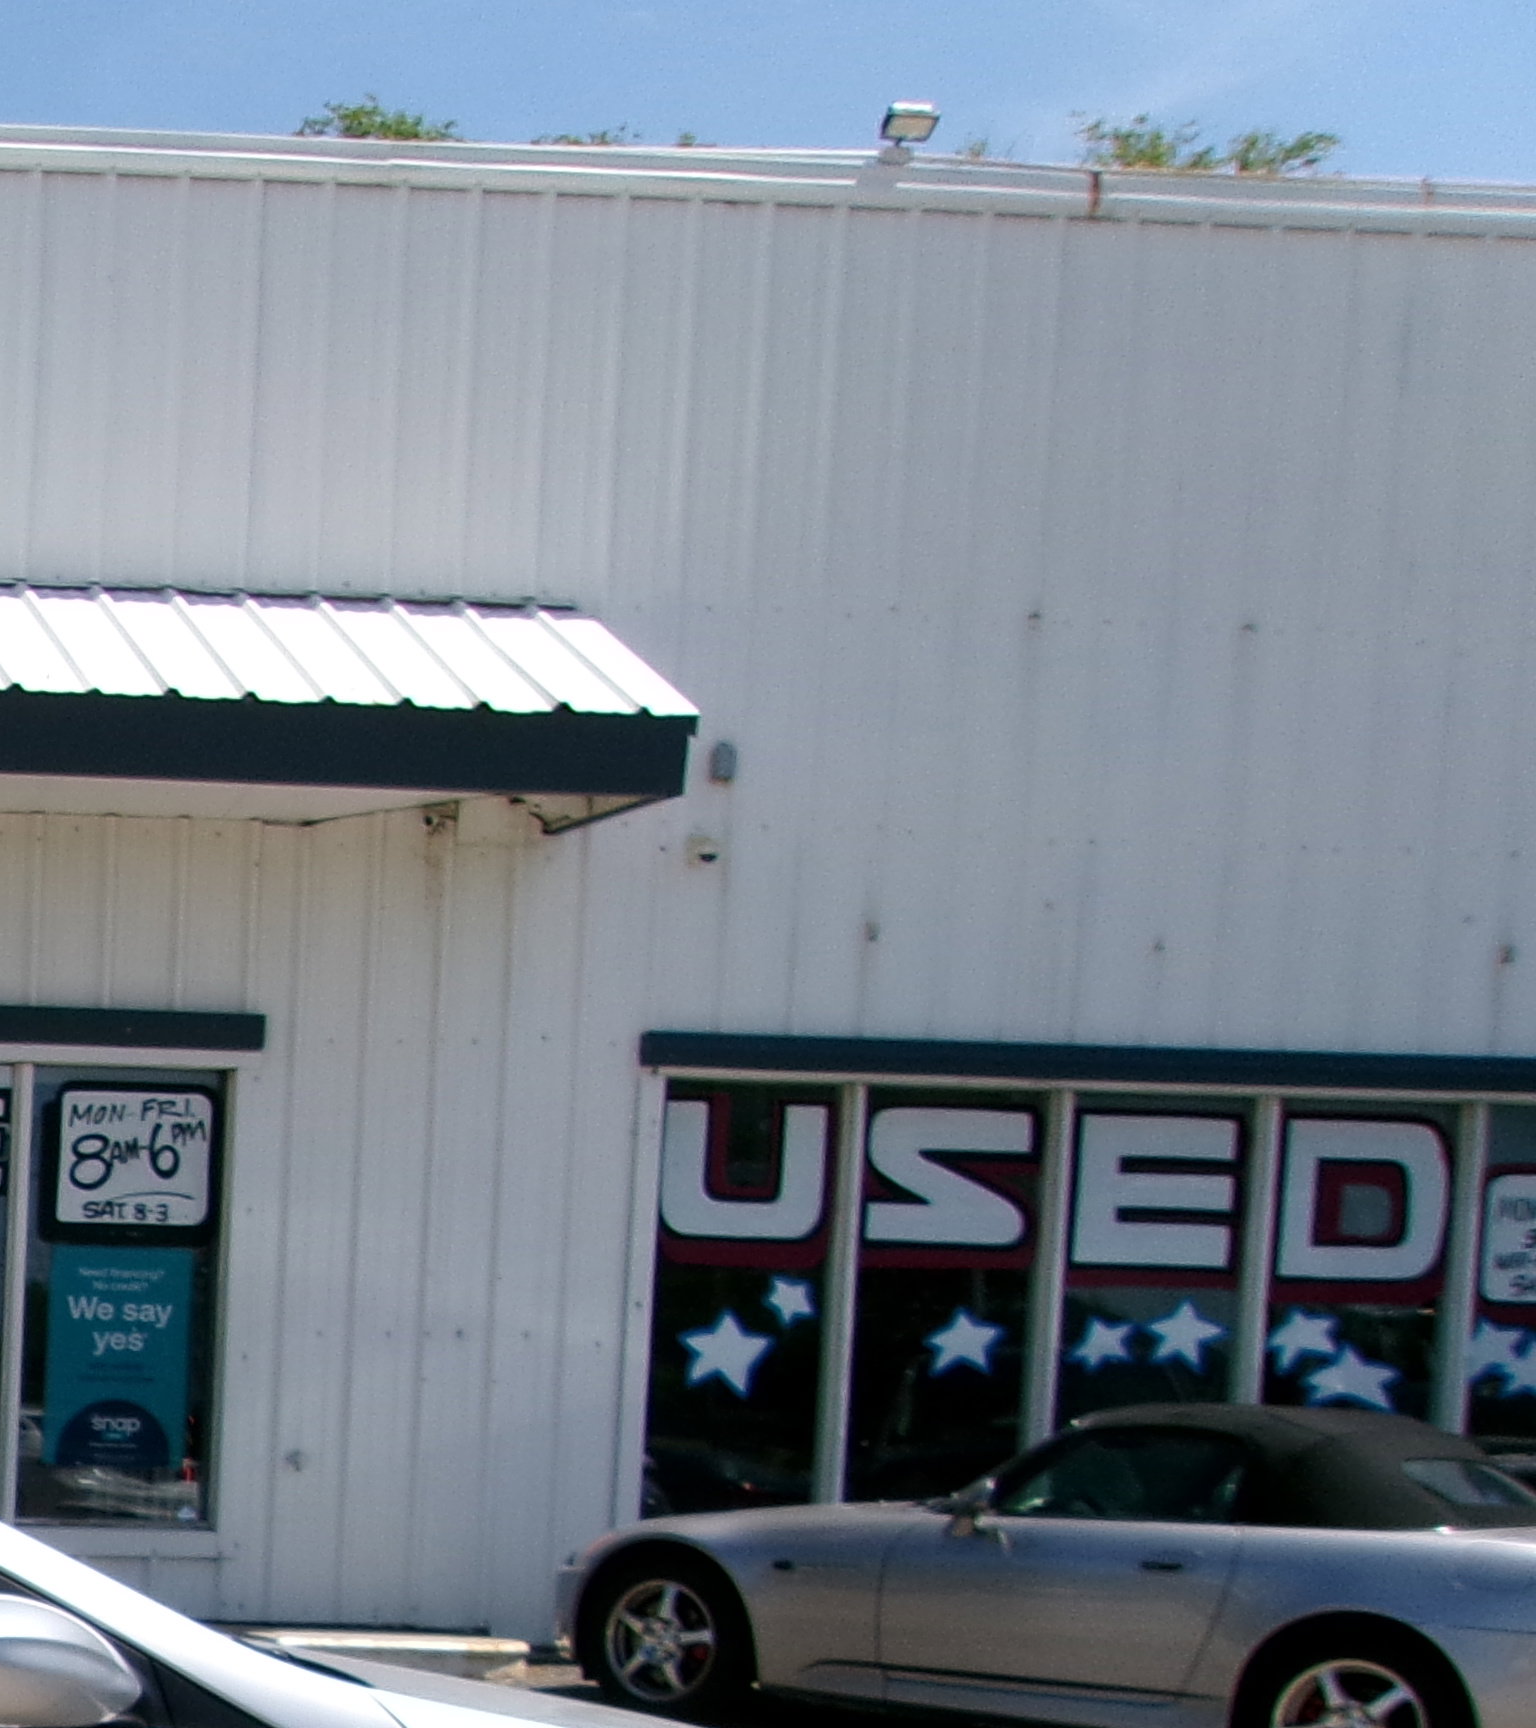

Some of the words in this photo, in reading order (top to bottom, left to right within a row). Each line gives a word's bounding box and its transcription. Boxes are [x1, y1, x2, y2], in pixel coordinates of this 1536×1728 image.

[659, 1098, 1452, 1284] USED
[82, 1201, 126, 1219] SAT
[67, 1295, 115, 1321] We
[122, 1303, 173, 1328] say
[92, 1330, 145, 1356] yes
[90, 1413, 142, 1437] snap
